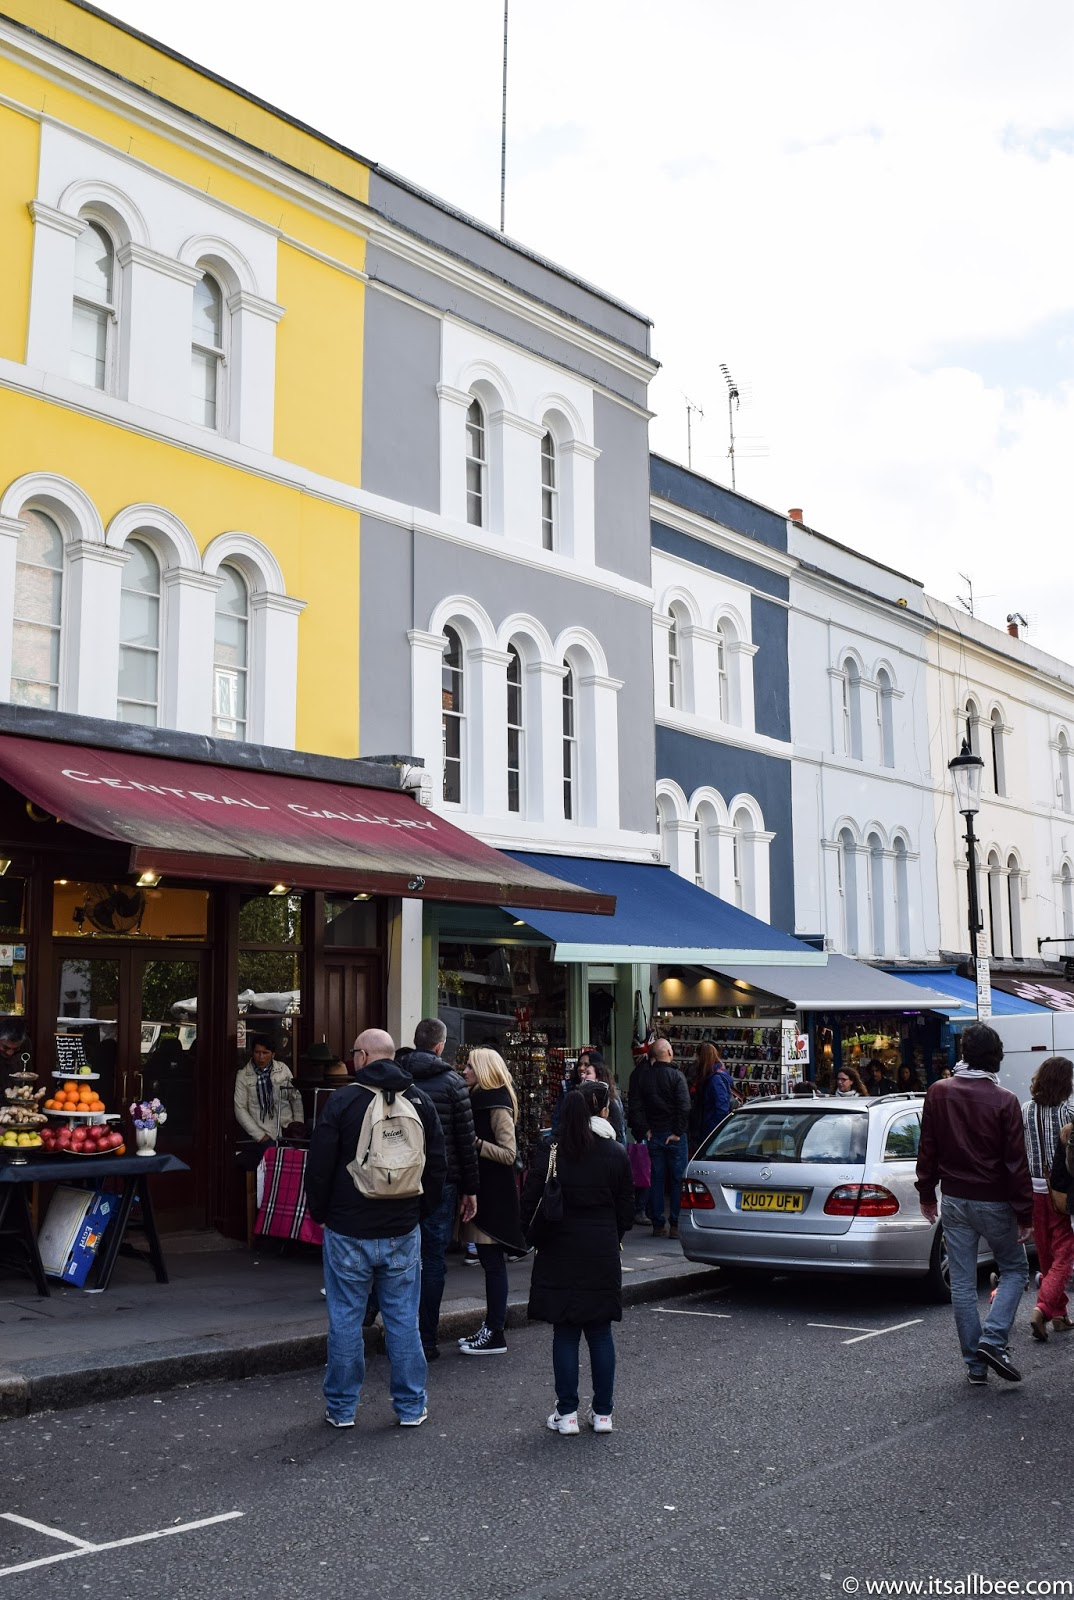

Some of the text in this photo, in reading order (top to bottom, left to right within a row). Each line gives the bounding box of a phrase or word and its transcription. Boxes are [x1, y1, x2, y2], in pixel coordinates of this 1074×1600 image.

[61, 768, 439, 831] CENTRAL GALLERY
[742, 1194, 801, 1208] KU07 UFW
